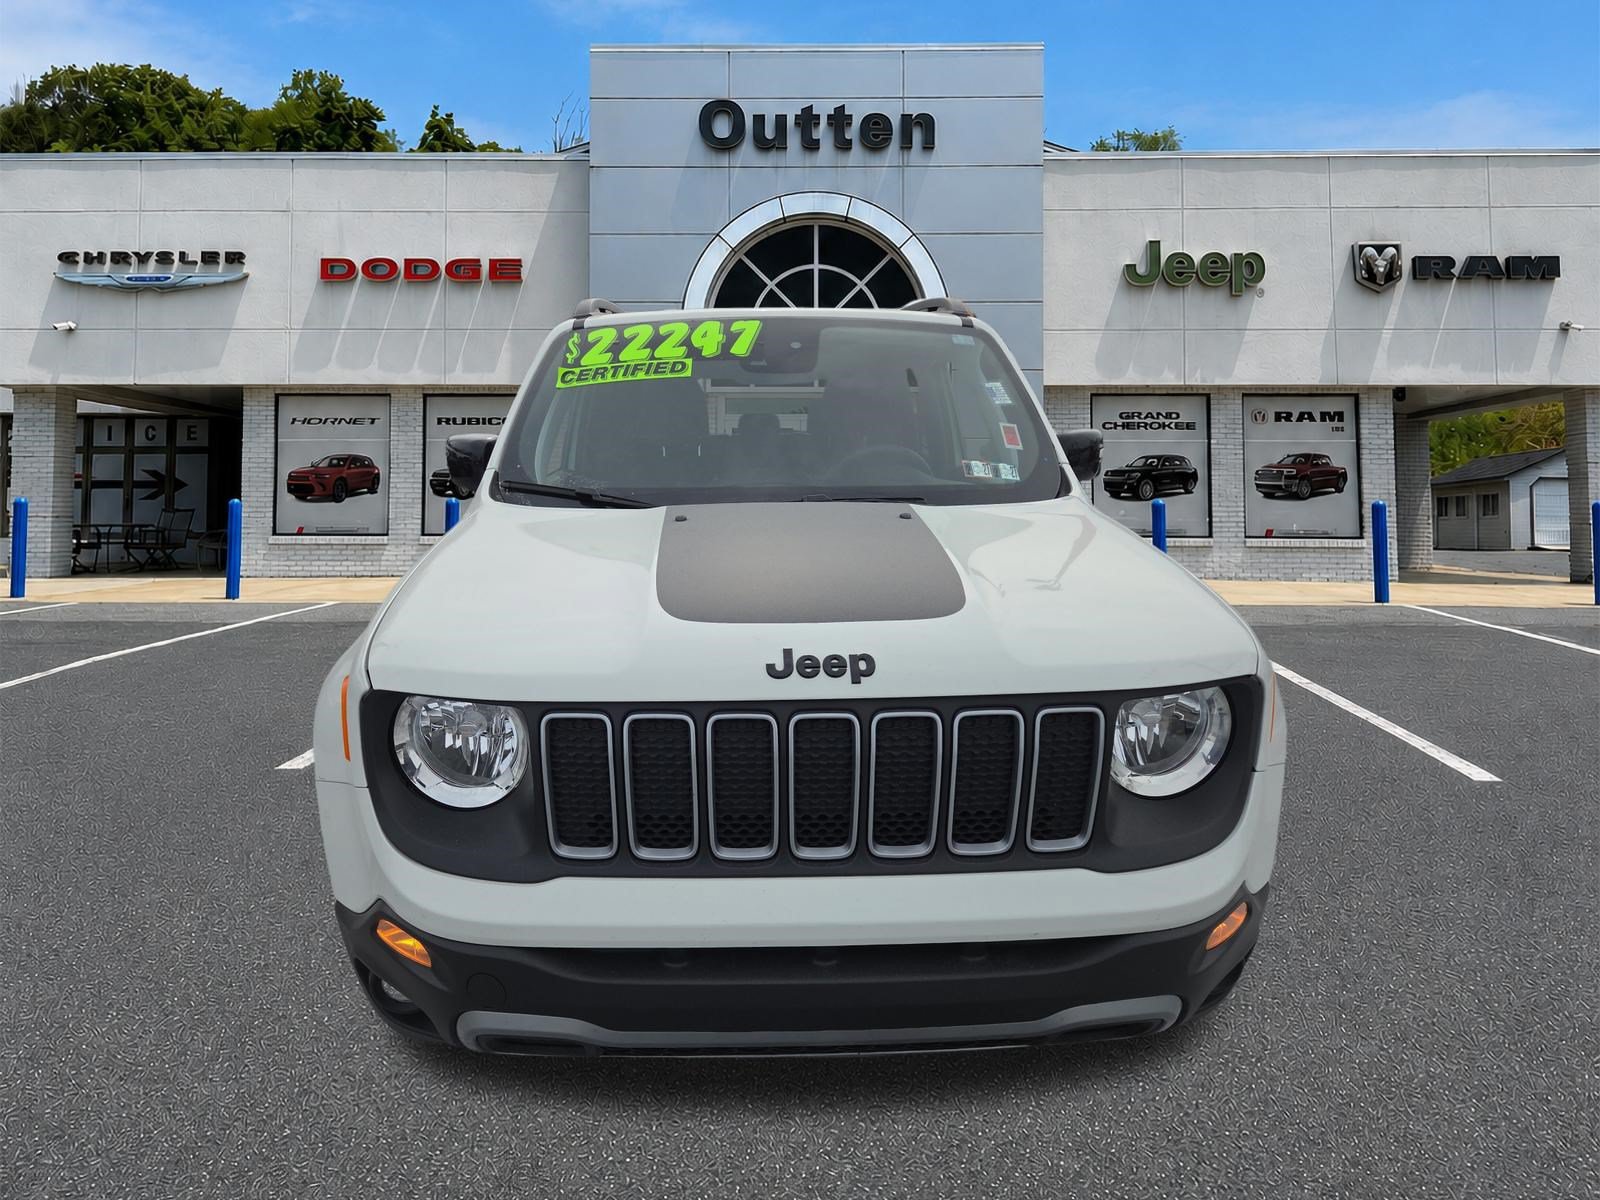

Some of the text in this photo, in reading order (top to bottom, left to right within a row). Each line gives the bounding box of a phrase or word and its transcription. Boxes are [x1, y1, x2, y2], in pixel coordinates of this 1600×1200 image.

[698, 99, 936, 150] Outten
[57, 251, 247, 266] CHRYSLER
[319, 257, 524, 282] DODGE
[1123, 240, 1266, 297] Jeep
[1411, 255, 1561, 281] RAM
[565, 319, 764, 366] $22247
[560, 359, 690, 385] CERTIFIED
[290, 416, 381, 426] HORNET
[1101, 421, 1197, 431] CHEROKEE
[1118, 411, 1181, 420] GRAND
[1273, 410, 1345, 423] RAM
[765, 648, 876, 685] Jeep
